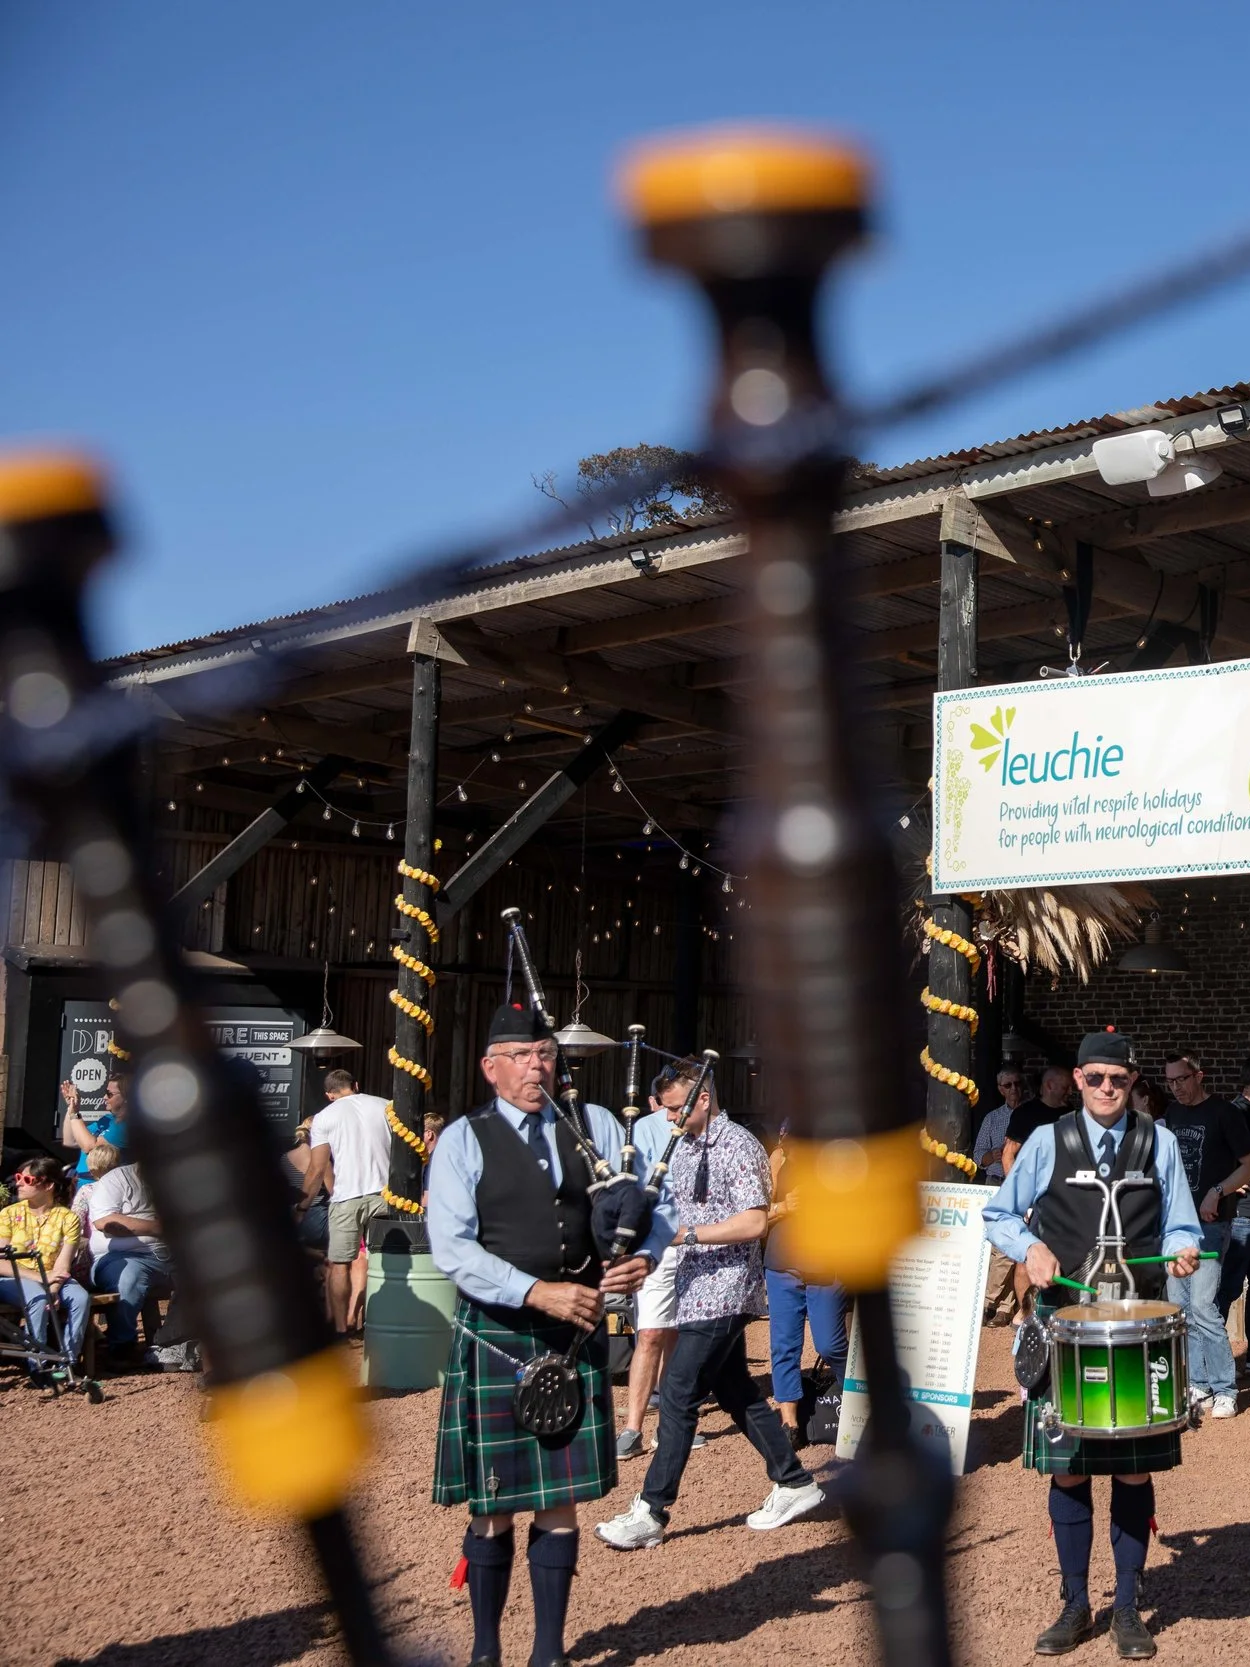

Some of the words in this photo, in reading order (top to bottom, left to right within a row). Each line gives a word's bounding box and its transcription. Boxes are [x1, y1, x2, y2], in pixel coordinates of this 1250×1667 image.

[1001, 730, 1124, 786] leuchie
[999, 801, 1058, 826] Providing
[1063, 794, 1090, 815] vital
[1094, 790, 1139, 822] respite
[1143, 788, 1202, 814] holidays
[998, 828, 1018, 849] for
[1021, 824, 1061, 856] people
[1064, 822, 1092, 843] with
[1096, 815, 1183, 847] neurological
[253, 1031, 268, 1041] THIS
[269, 1031, 289, 1041] SPACE
[75, 1069, 102, 1080] OPEN
[927, 1195, 941, 1206] IN
[946, 1196, 970, 1208] THE
[1104, 1263, 1117, 1274] M
[1150, 1356, 1170, 1415] Pearl
[921, 1391, 958, 1403] SPONSORS
